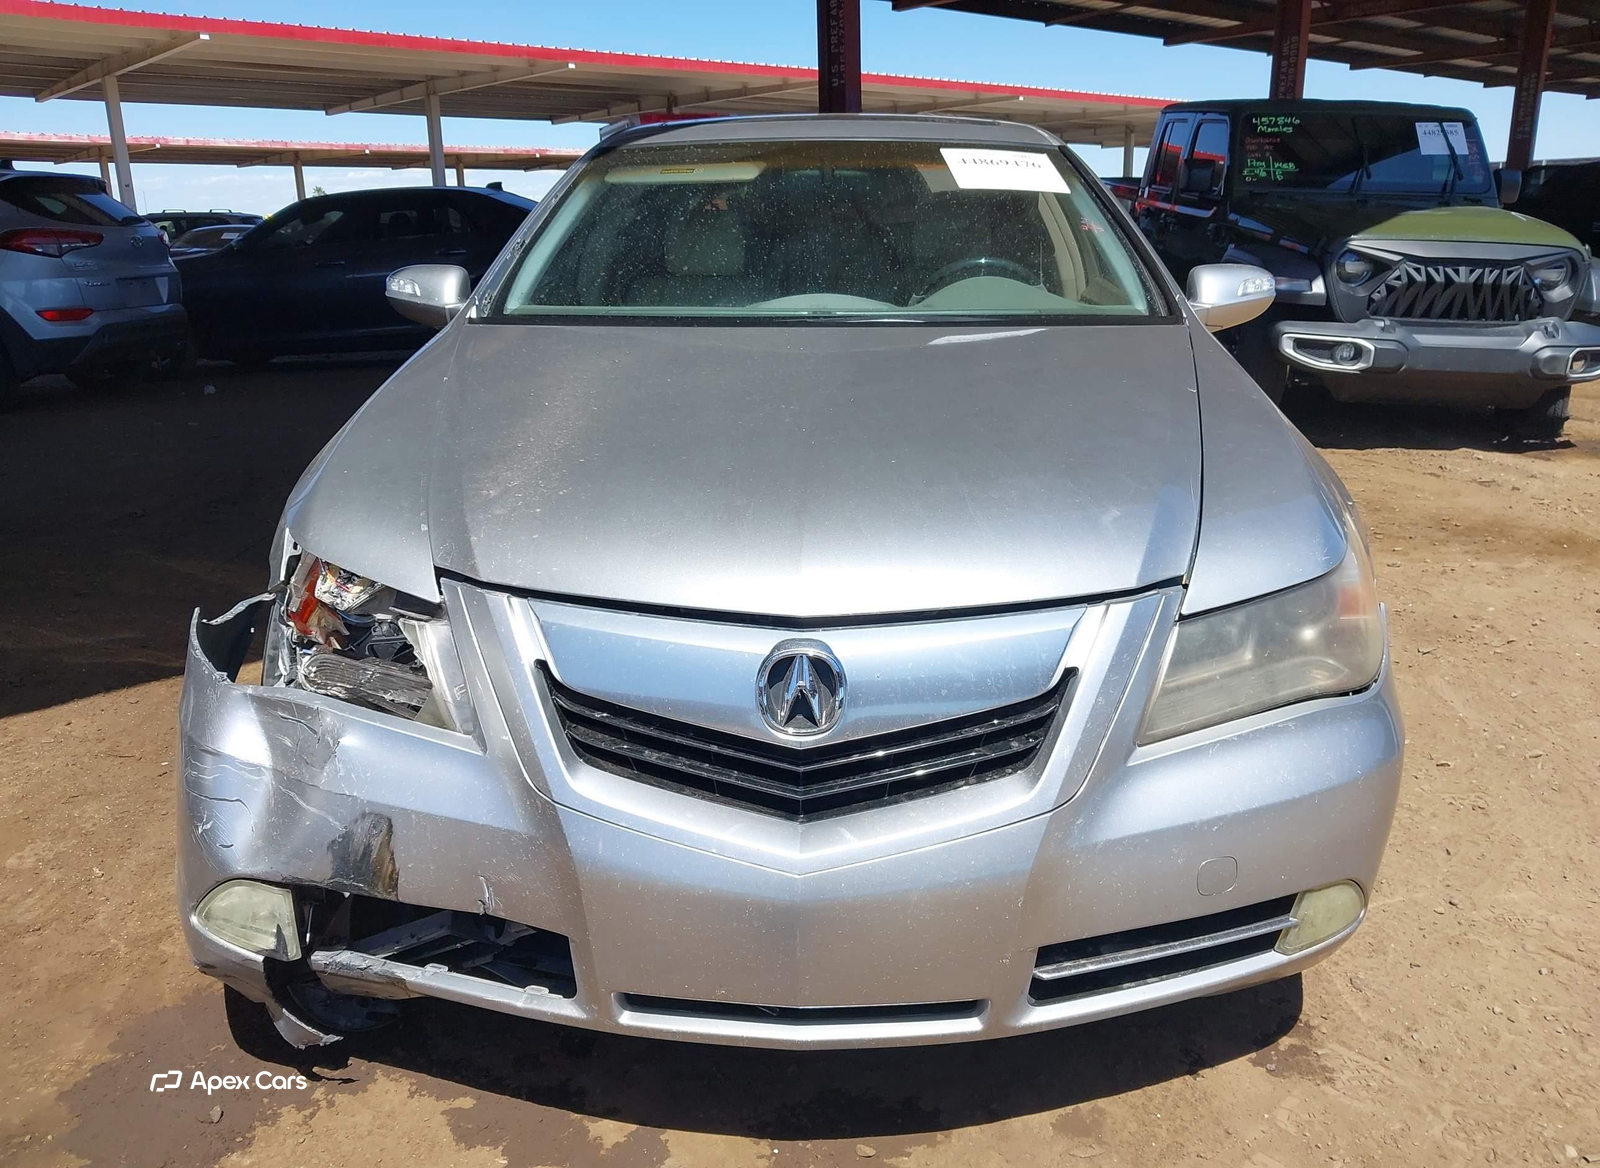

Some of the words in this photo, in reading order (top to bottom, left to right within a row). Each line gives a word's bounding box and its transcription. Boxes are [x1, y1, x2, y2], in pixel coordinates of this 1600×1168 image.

[829, 0, 839, 54] PREFAB
[1252, 115, 1301, 126] 457846
[1256, 125, 1294, 134] Morales
[957, 157, 1042, 169] 44869476
